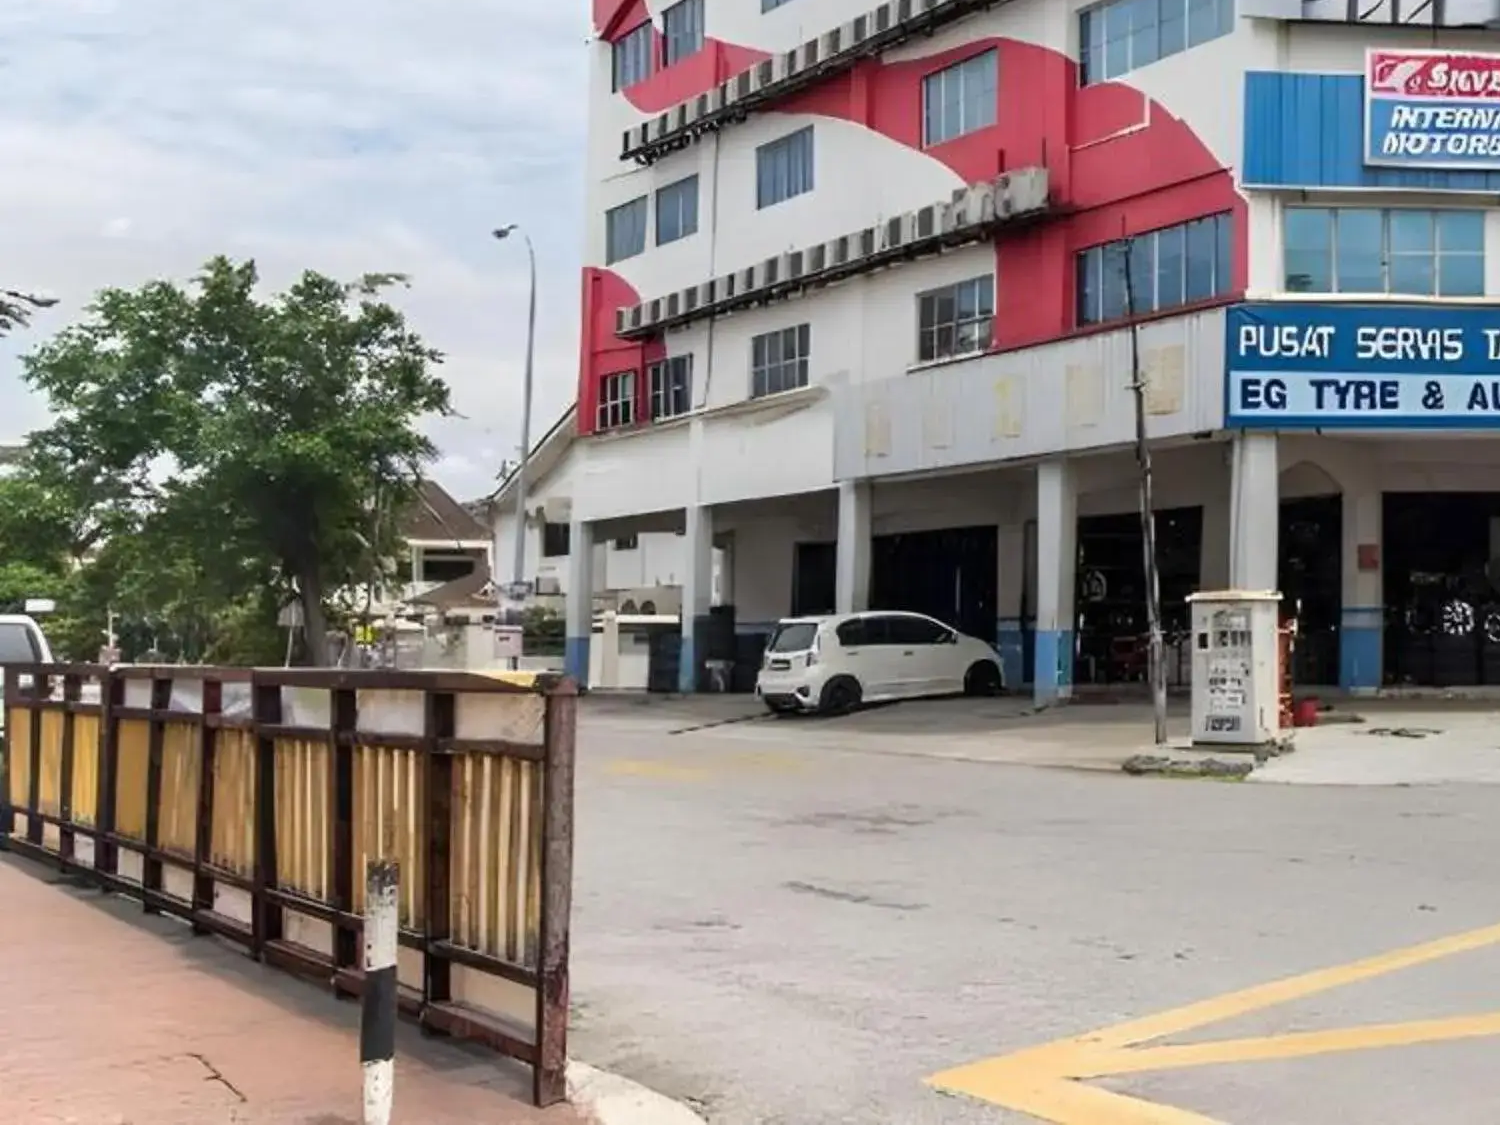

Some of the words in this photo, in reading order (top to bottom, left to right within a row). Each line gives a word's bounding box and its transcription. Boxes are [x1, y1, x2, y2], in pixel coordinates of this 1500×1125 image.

[1239, 325, 1335, 358] PUSAT
[1356, 327, 1463, 361] SERVIS
[1240, 378, 1287, 410] EG
[1308, 379, 1400, 410] TYRE
[1421, 380, 1445, 410] &
